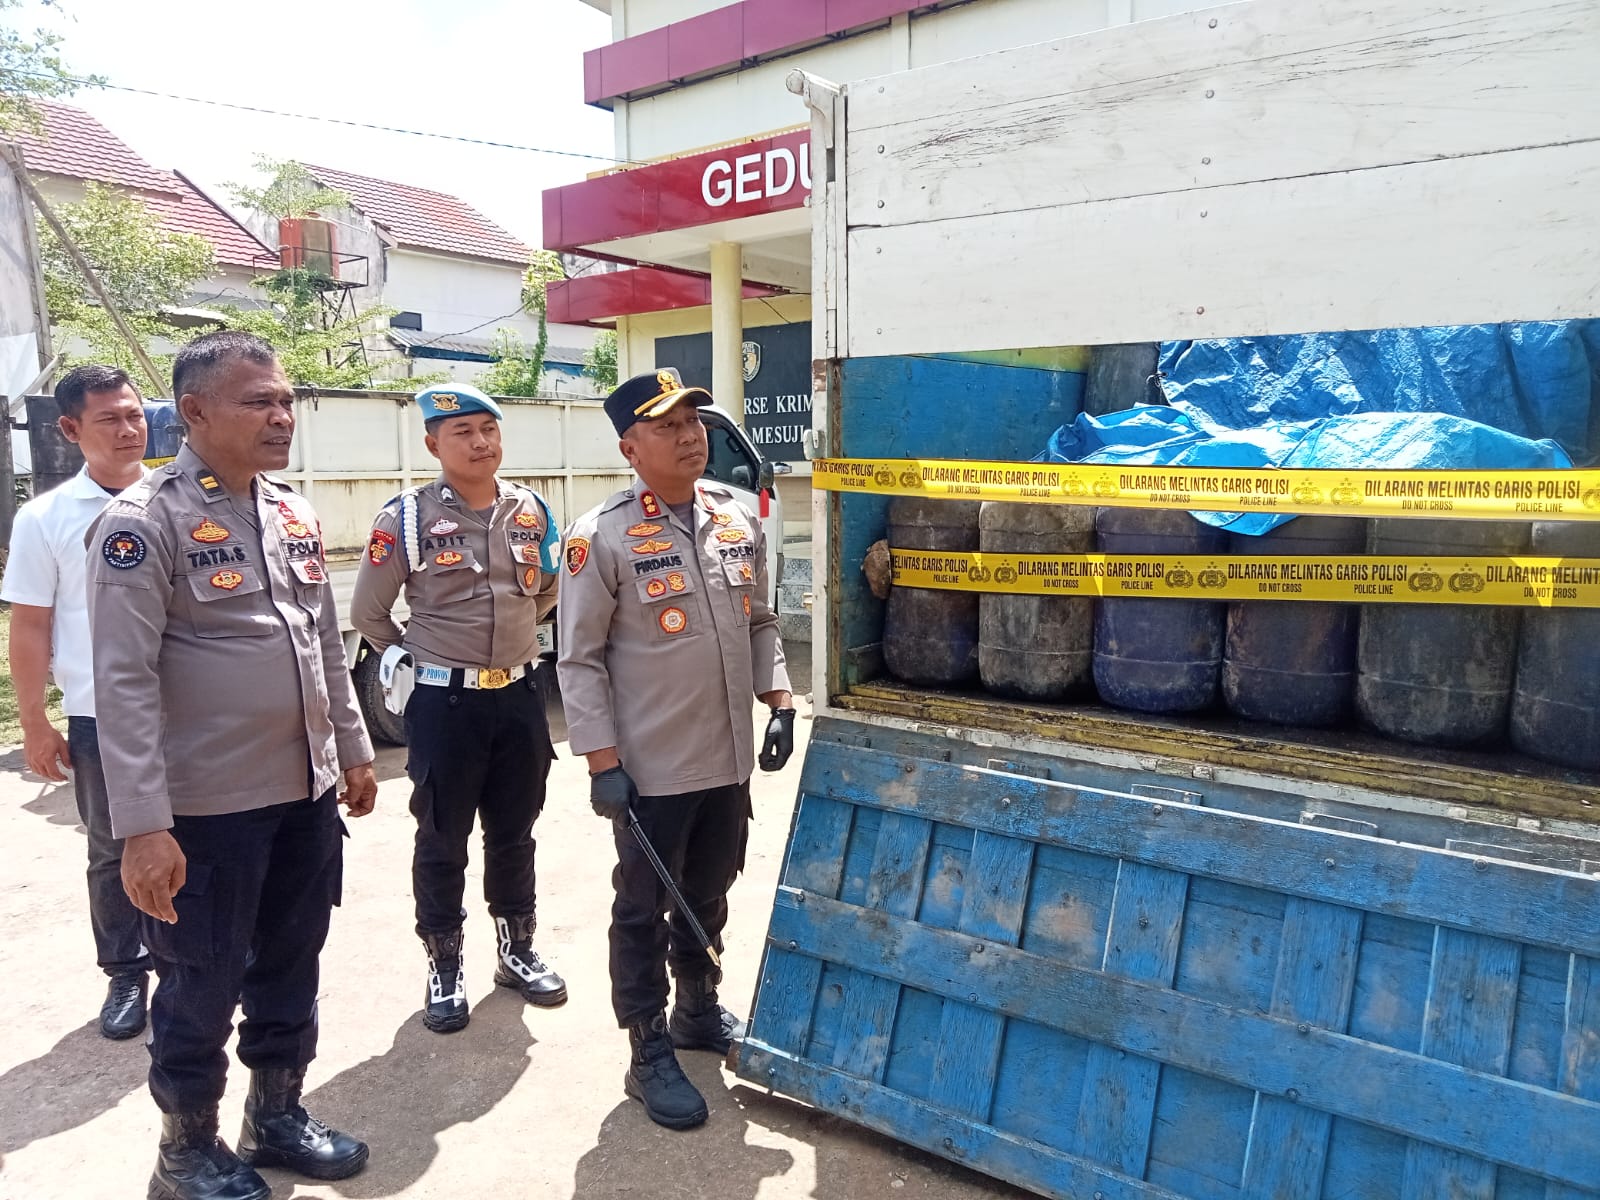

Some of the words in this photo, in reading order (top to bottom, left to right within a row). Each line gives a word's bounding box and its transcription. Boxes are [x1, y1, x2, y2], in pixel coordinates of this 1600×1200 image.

[752, 425, 804, 444] MESUJI
[829, 462, 849, 475] GARIS
[851, 463, 874, 477] POLISI
[922, 467, 960, 483] DILARANG
[962, 468, 1003, 485] MELINTAS
[1005, 471, 1029, 486] GARIS
[1032, 472, 1060, 487] POLISI
[1120, 474, 1166, 490] DILARANG
[1169, 476, 1219, 493] MELINTAS
[1222, 478, 1252, 493] GARIS
[1255, 478, 1290, 495] POLISI
[1365, 480, 1423, 497] DILARANG
[1428, 481, 1490, 498] MELINTAS
[1494, 481, 1533, 498] GARIS
[1537, 480, 1580, 499] POLISI
[1150, 494, 1158, 502] DO
[1159, 494, 1170, 503] NOT
[1171, 494, 1190, 503] CROSS
[1240, 496, 1261, 505] POLICE
[1263, 497, 1277, 506] LINE
[1402, 500, 1412, 510] DO
[1414, 500, 1427, 510] NOT
[1430, 500, 1453, 511] CROSS
[1515, 502, 1543, 512] POLICE
[1546, 503, 1563, 512] LINE
[425, 535, 465, 550] ADIT
[187, 546, 245, 568] TATA.S
[634, 555, 682, 575] FIRDAUS
[922, 557, 942, 571] GARIS
[945, 559, 968, 573] POLISI
[1018, 561, 1058, 576] DILARANG
[1061, 561, 1104, 577] MELINTAS
[1107, 562, 1132, 577] GARIS
[1135, 563, 1164, 578] POLISI
[1228, 563, 1277, 579] DILARANG
[1281, 564, 1333, 580] MELINTAS
[1336, 564, 1368, 580] GARIS
[1372, 564, 1407, 581] POLISI
[933, 574, 948, 583] POLICE
[949, 575, 959, 583] LINE
[1486, 565, 1547, 583] DILARANG
[1552, 567, 1600, 585] MELINT
[1044, 579, 1051, 587] DO
[1051, 579, 1061, 588] NOT
[1062, 579, 1079, 589] CROSS
[1121, 580, 1139, 590] POLICE
[1140, 581, 1153, 590] LINE
[1258, 583, 1267, 592] DO
[1269, 583, 1280, 592] NOT
[1282, 583, 1302, 593] CROSS
[1354, 584, 1376, 594] POLICE
[1378, 584, 1393, 595] LINE
[1524, 587, 1533, 597] DO
[1536, 587, 1551, 598] NOT
[1552, 588, 1577, 599] CROSS
[427, 668, 449, 680] PROVOS
